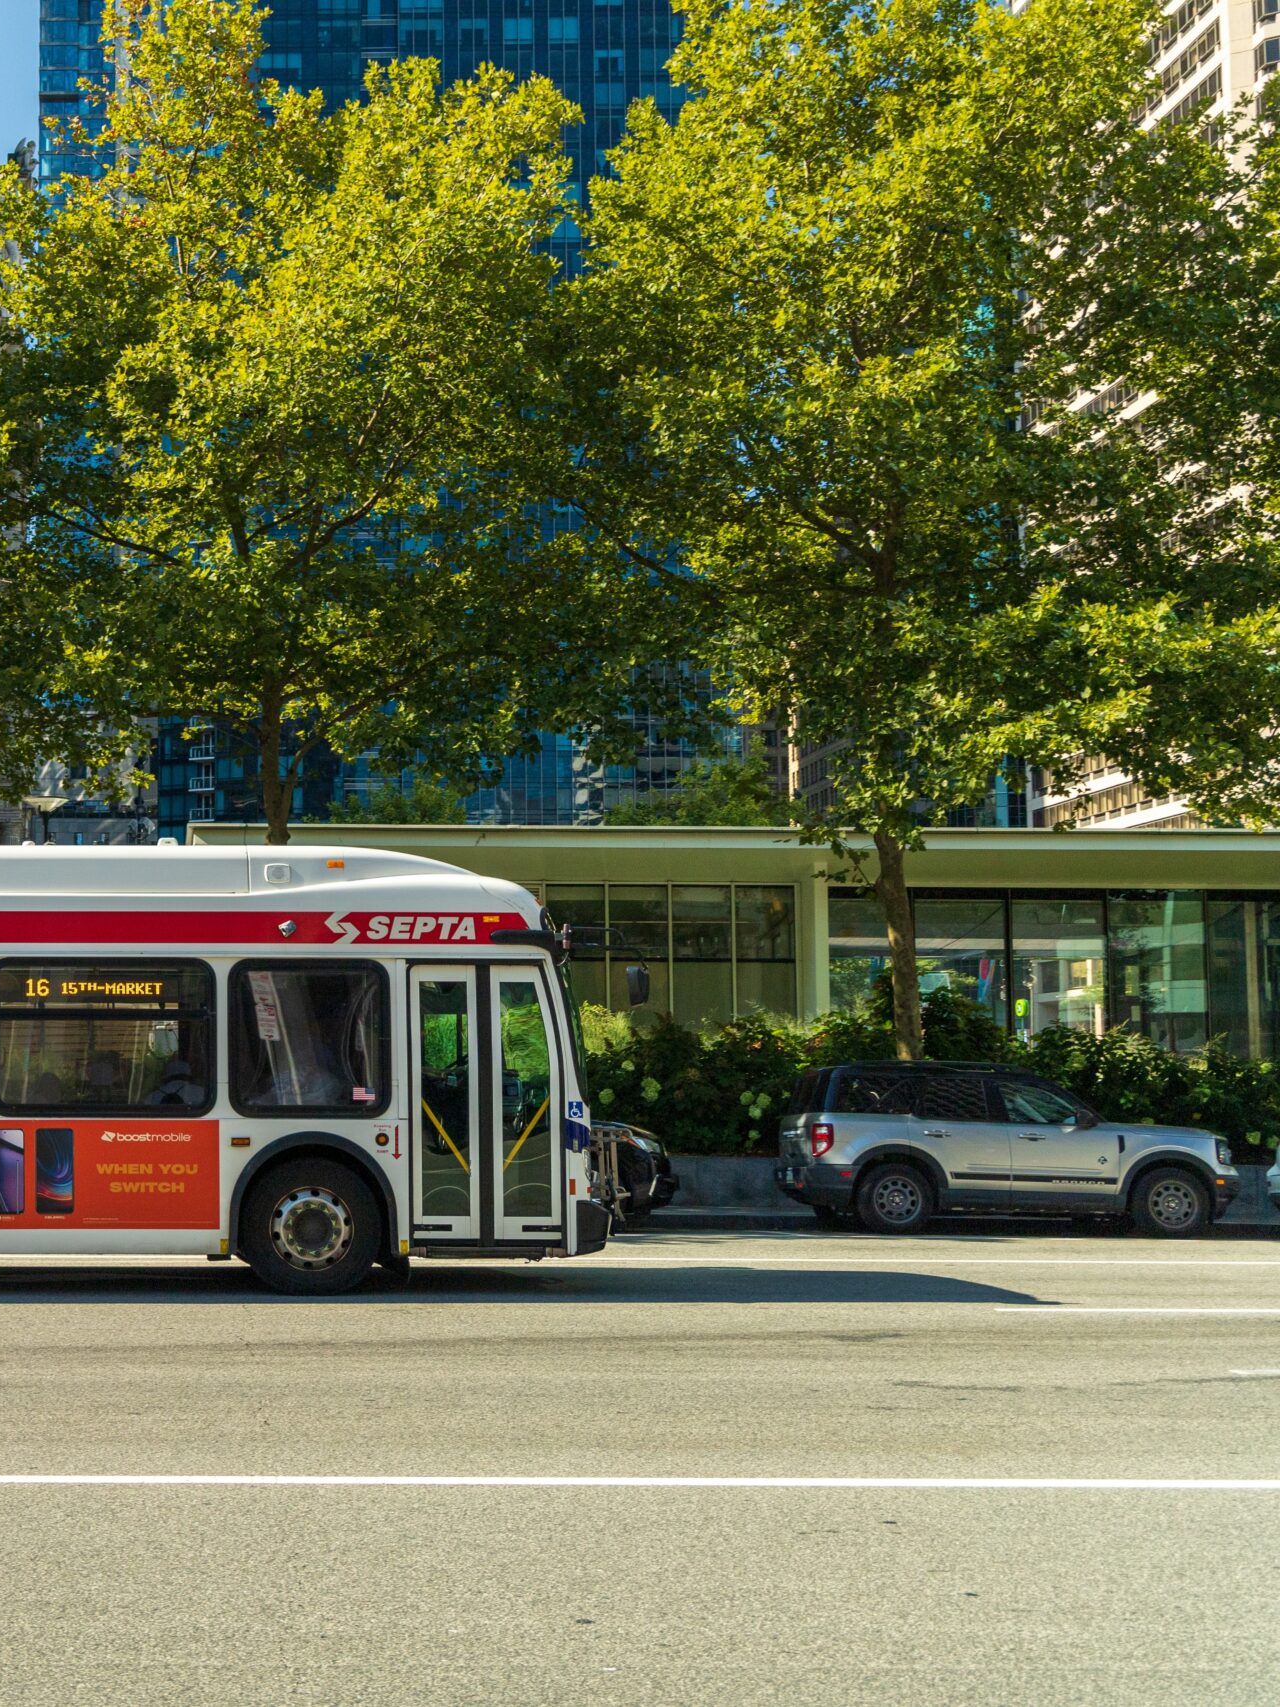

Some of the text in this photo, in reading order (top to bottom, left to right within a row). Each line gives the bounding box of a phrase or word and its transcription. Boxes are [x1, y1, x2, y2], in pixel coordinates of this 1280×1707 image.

[366, 915, 477, 940] SEPTA
[25, 978, 163, 997] 16 15TH-MARKET
[116, 1132, 192, 1142] boostmobile
[96, 1163, 199, 1175] WHEN YOU
[109, 1182, 185, 1193] SWITCH
